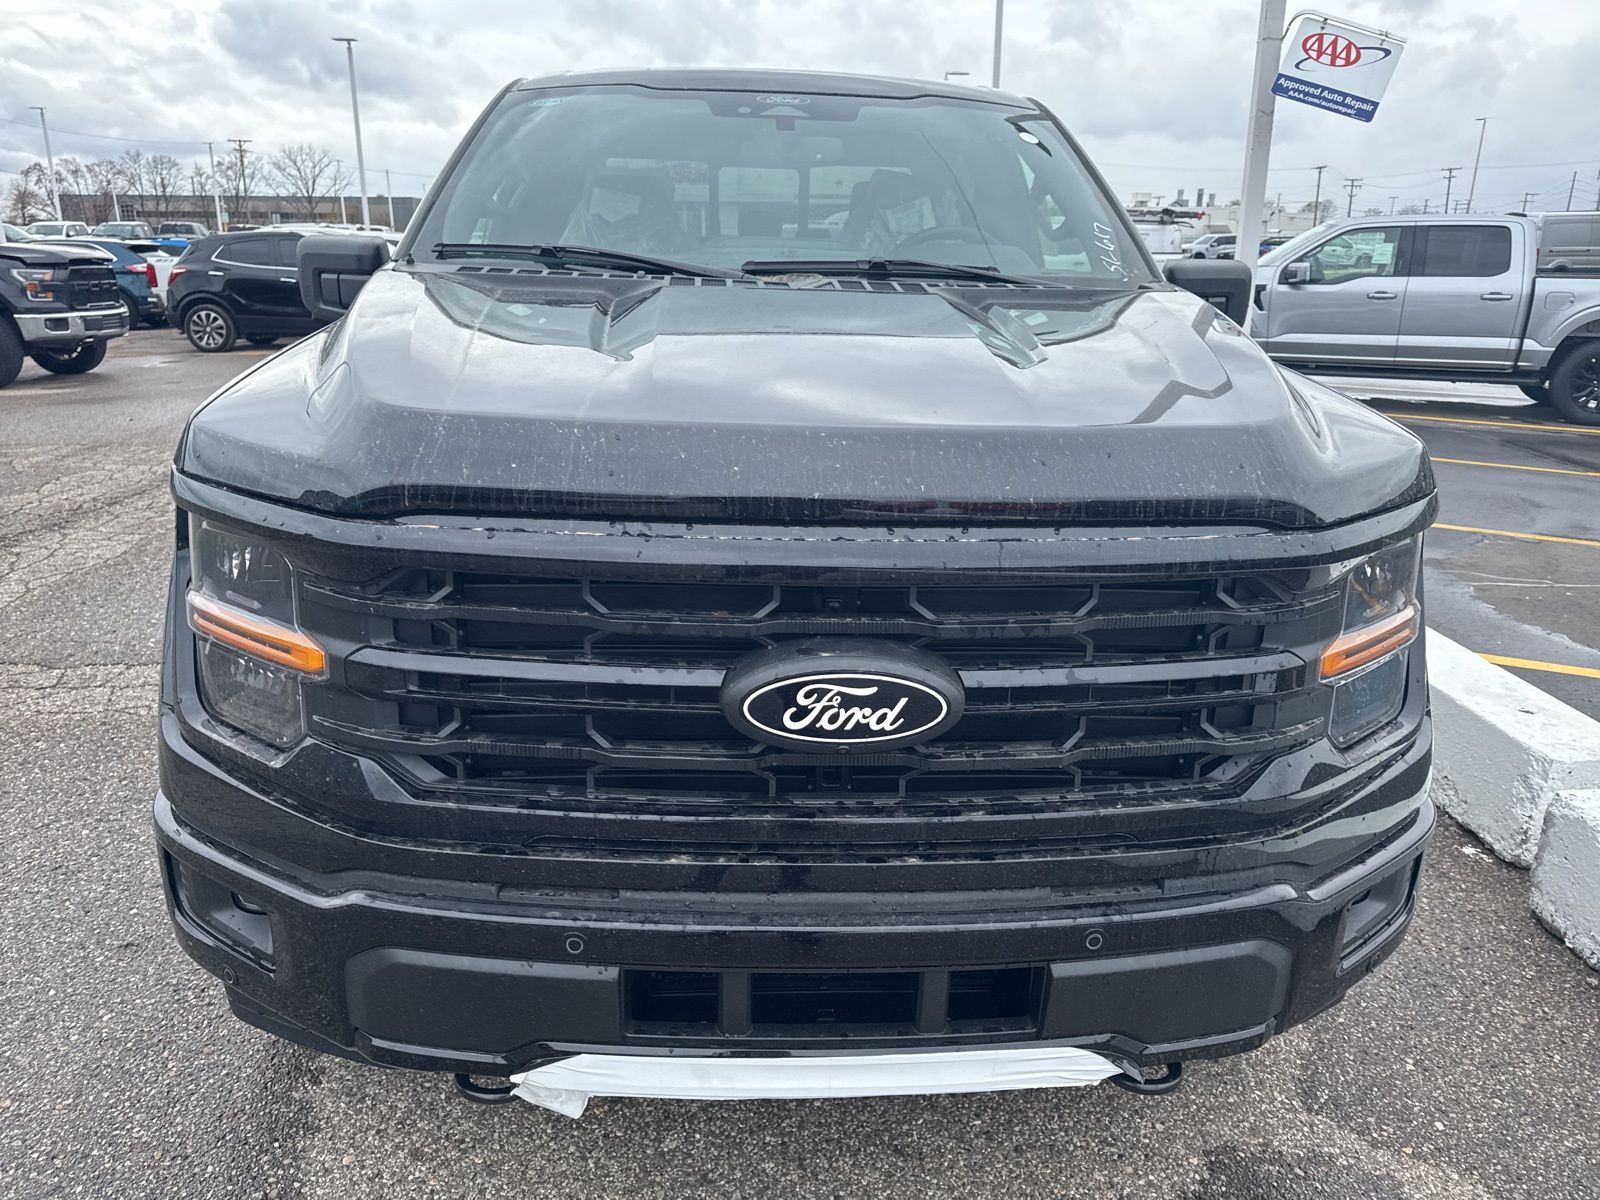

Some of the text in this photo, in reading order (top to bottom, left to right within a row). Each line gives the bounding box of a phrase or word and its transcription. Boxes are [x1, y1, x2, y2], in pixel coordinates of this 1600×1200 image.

[1304, 33, 1356, 67] AAA
[1278, 77, 1375, 112] Approved Auto Repair
[1287, 90, 1357, 115] AAA.com/autorepair
[782, 683, 909, 731] Ford
